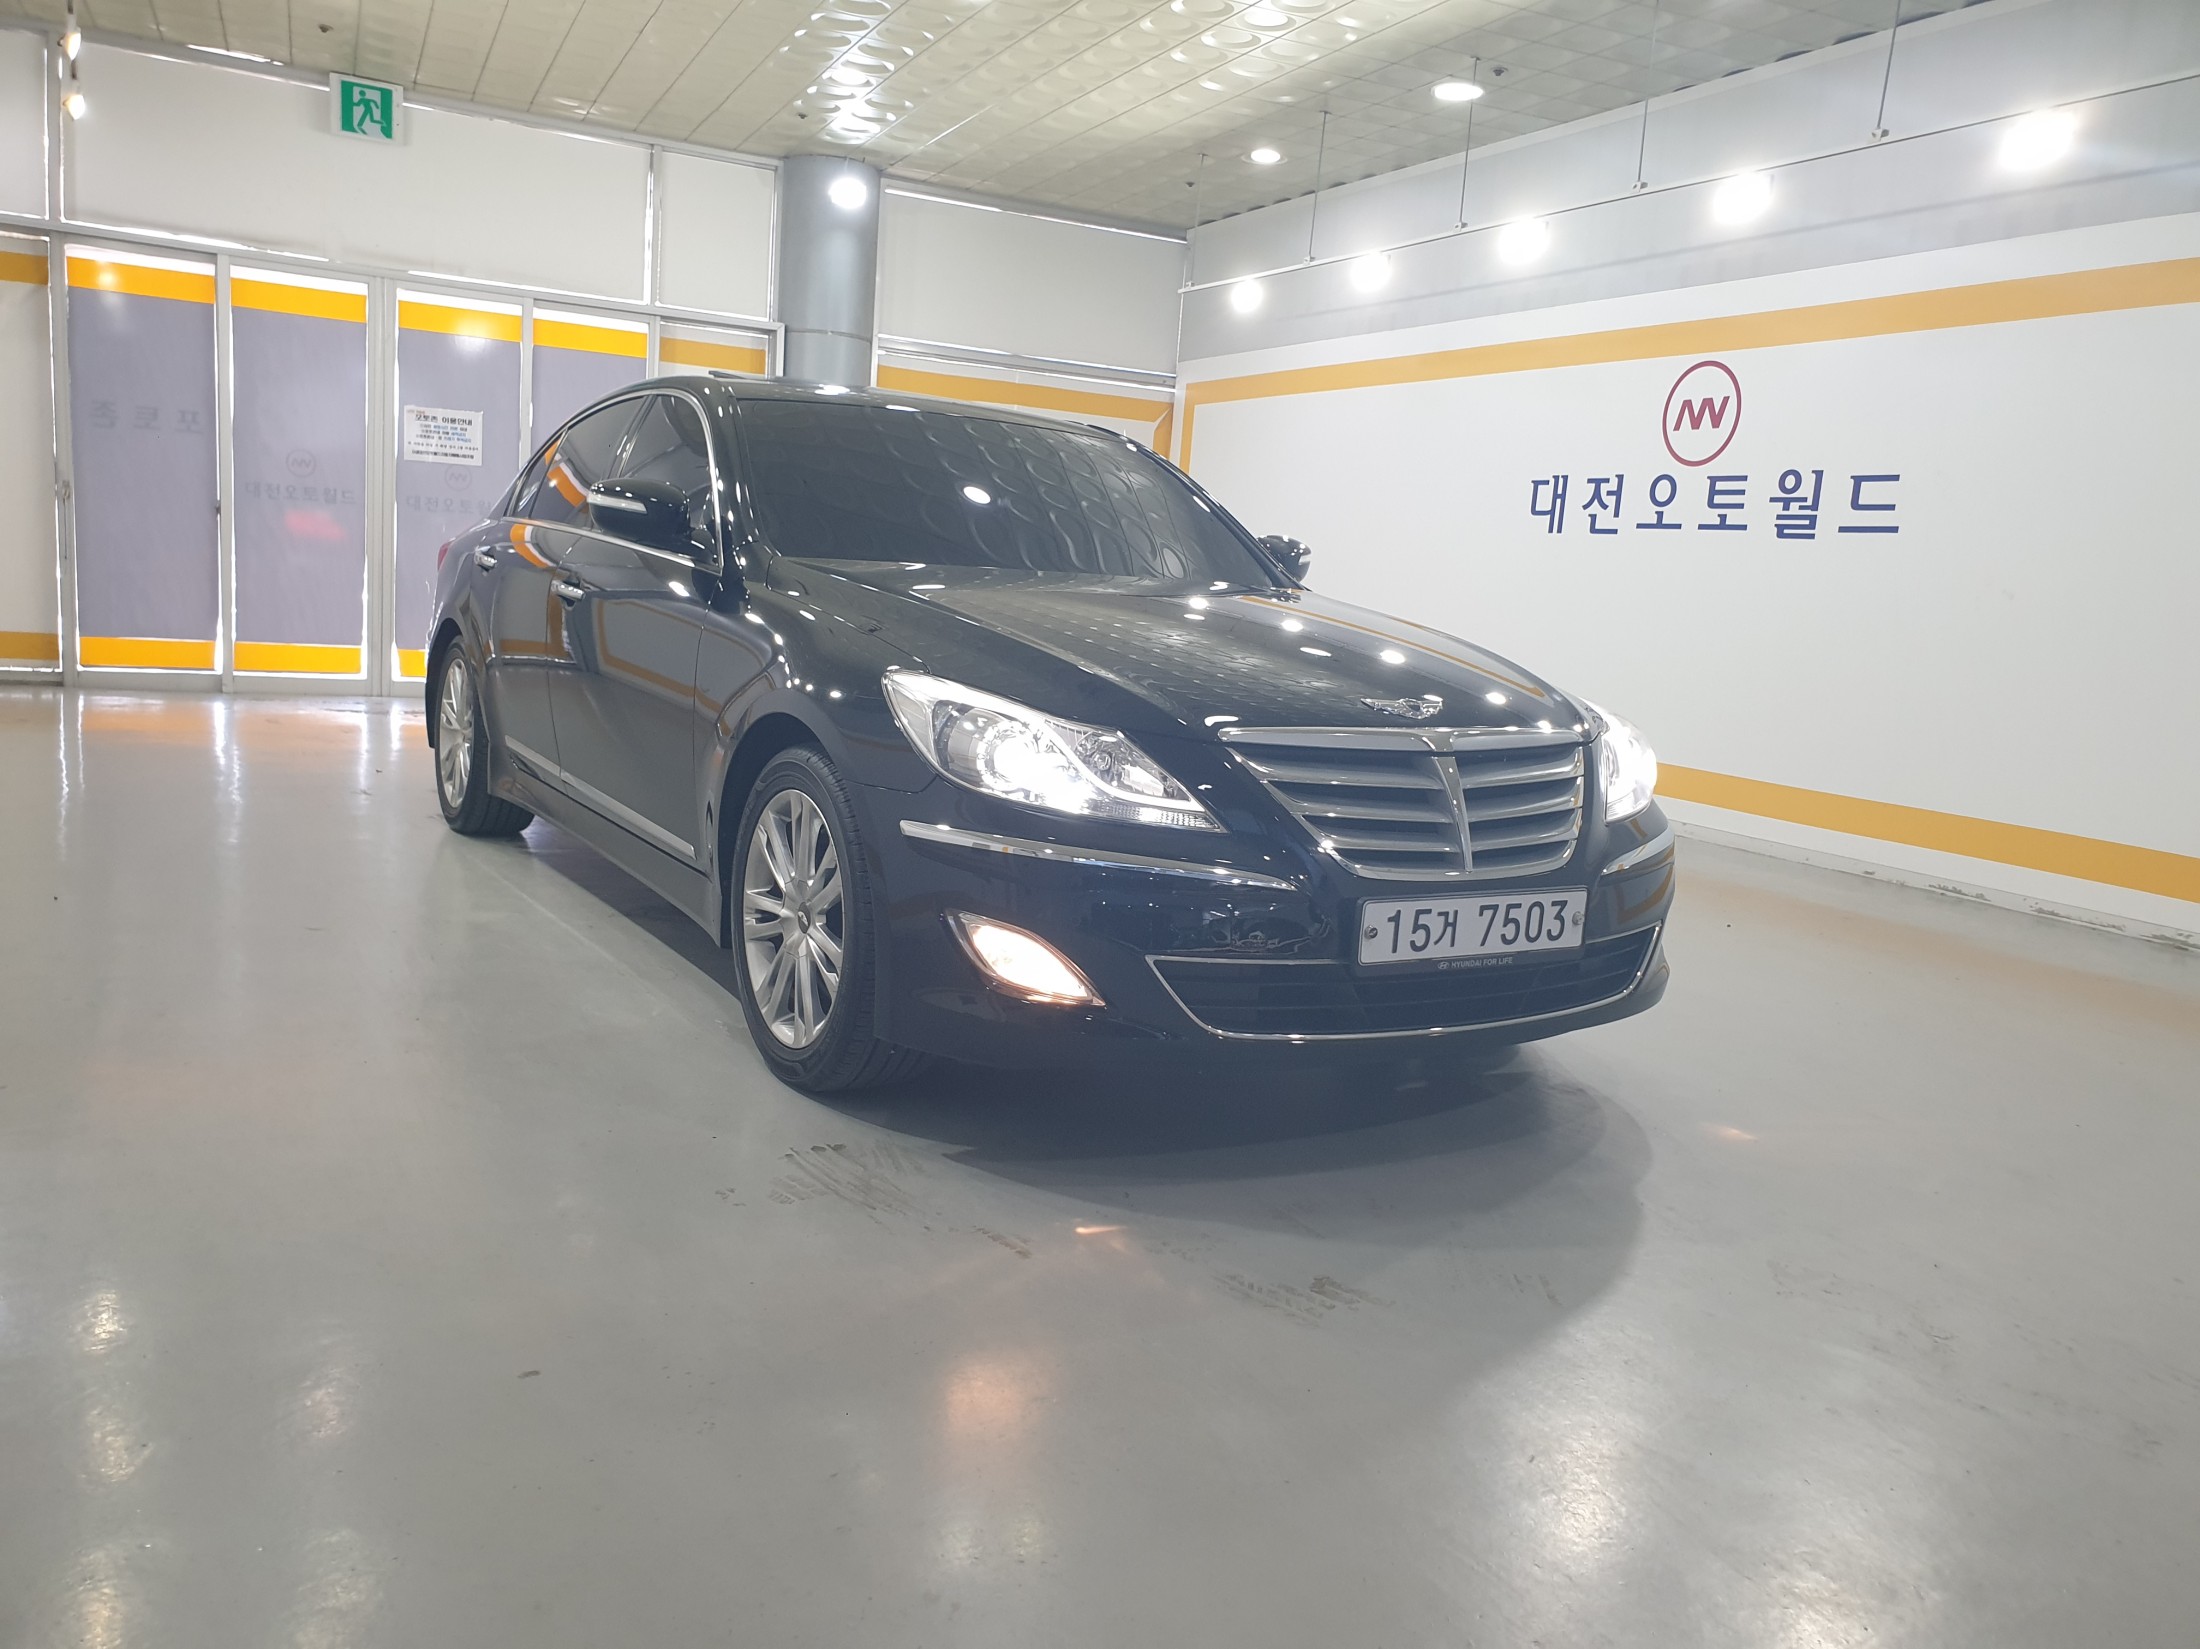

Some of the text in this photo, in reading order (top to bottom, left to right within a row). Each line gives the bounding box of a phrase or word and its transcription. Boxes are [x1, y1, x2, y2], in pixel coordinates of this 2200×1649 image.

[244, 481, 357, 505] 대전오토월드
[1530, 469, 1900, 540] 대전오토월드
[406, 495, 492, 516] 대전오토월
[1386, 900, 1569, 954] 15거 7503
[1451, 956, 1513, 969] HYUNDAI FOR LIFE
